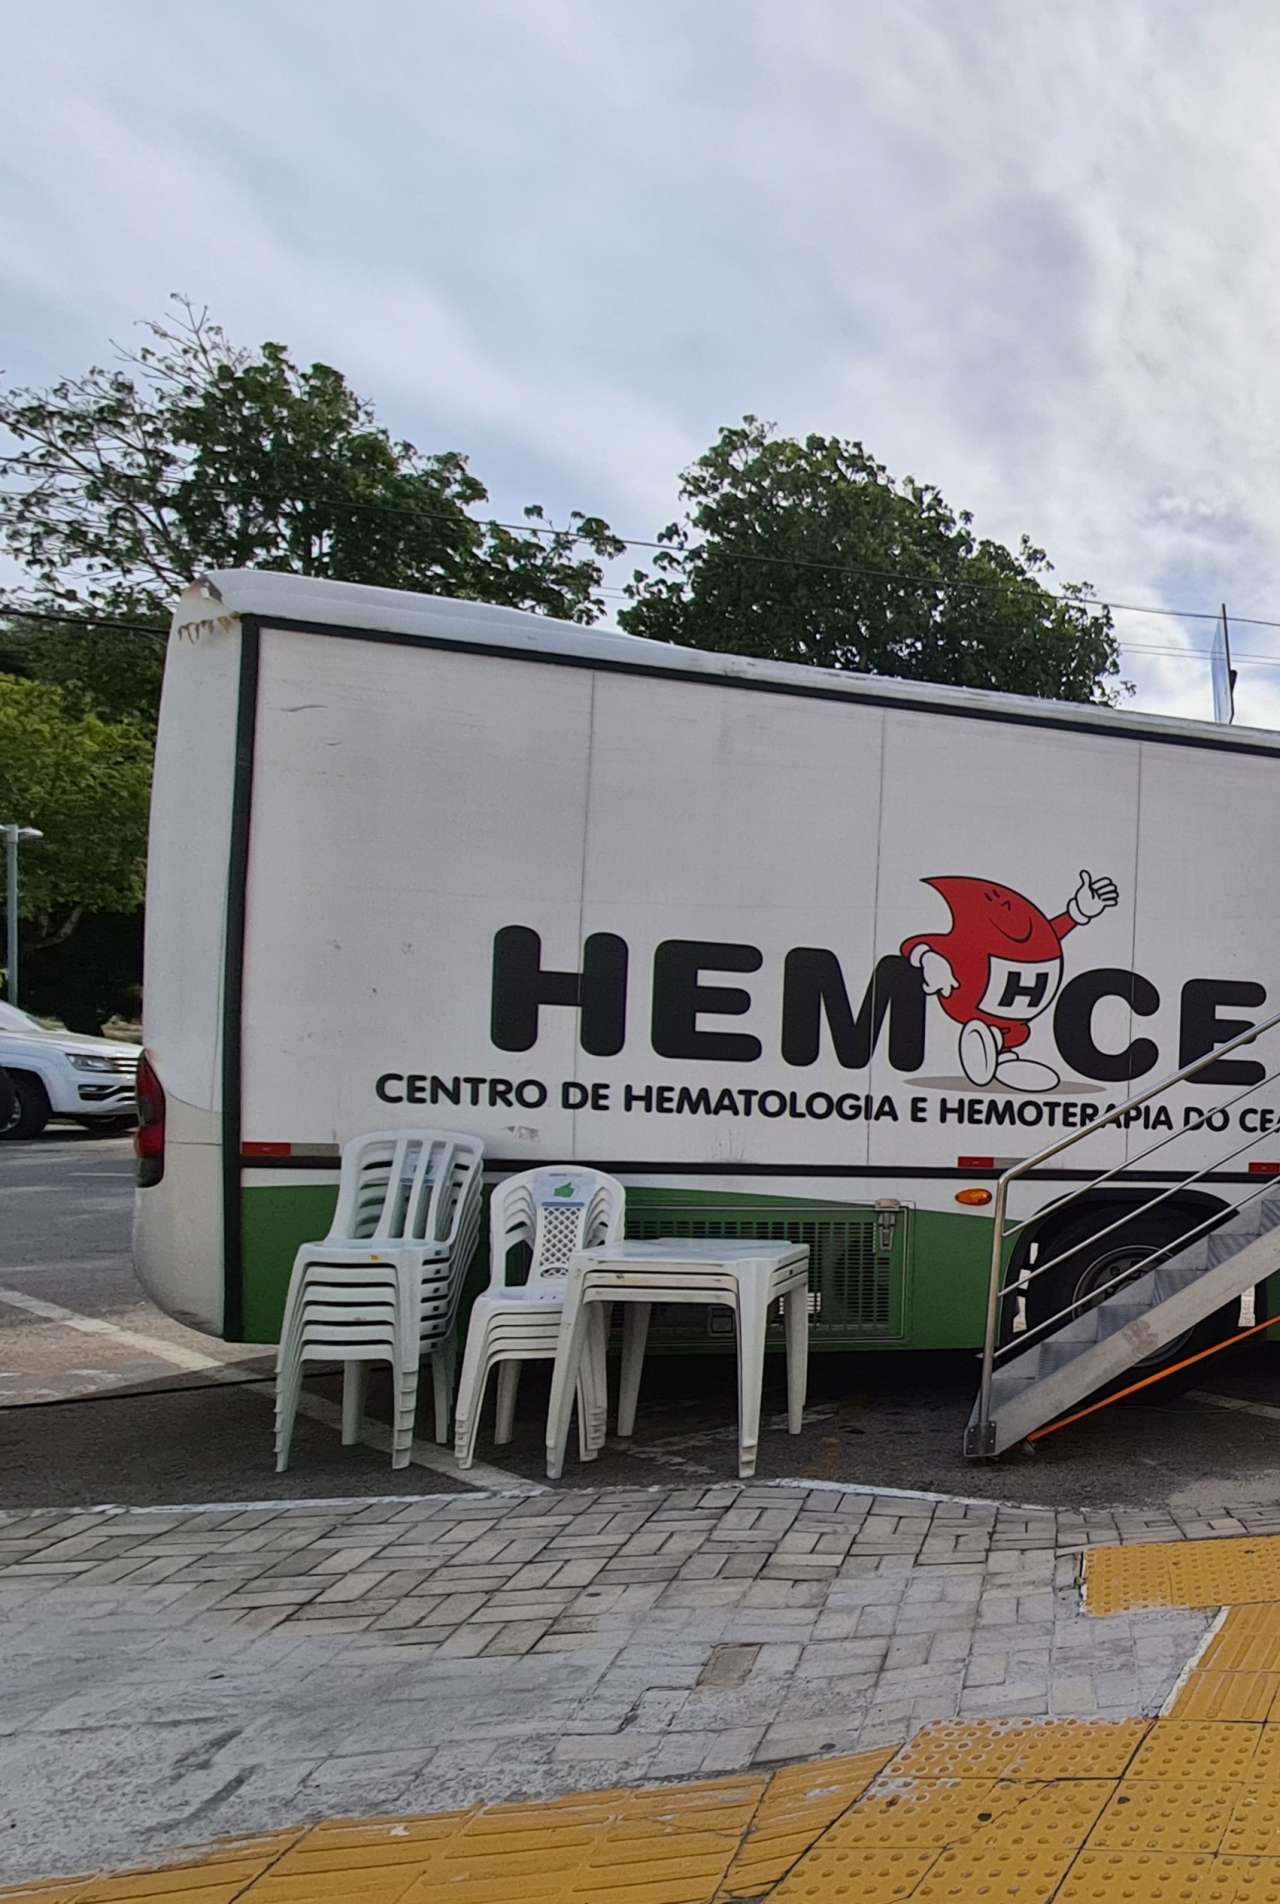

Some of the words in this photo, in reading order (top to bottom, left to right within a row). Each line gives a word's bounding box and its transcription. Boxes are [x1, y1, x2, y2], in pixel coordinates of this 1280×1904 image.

[375, 1072, 548, 1109] CENTRO
[561, 1081, 611, 1111] DE
[624, 1084, 899, 1122] HEMATOLOGIA
[911, 1097, 928, 1123] E
[939, 1098, 1174, 1131] HEMOTERAPIA
[1184, 1106, 1230, 1132] DO
